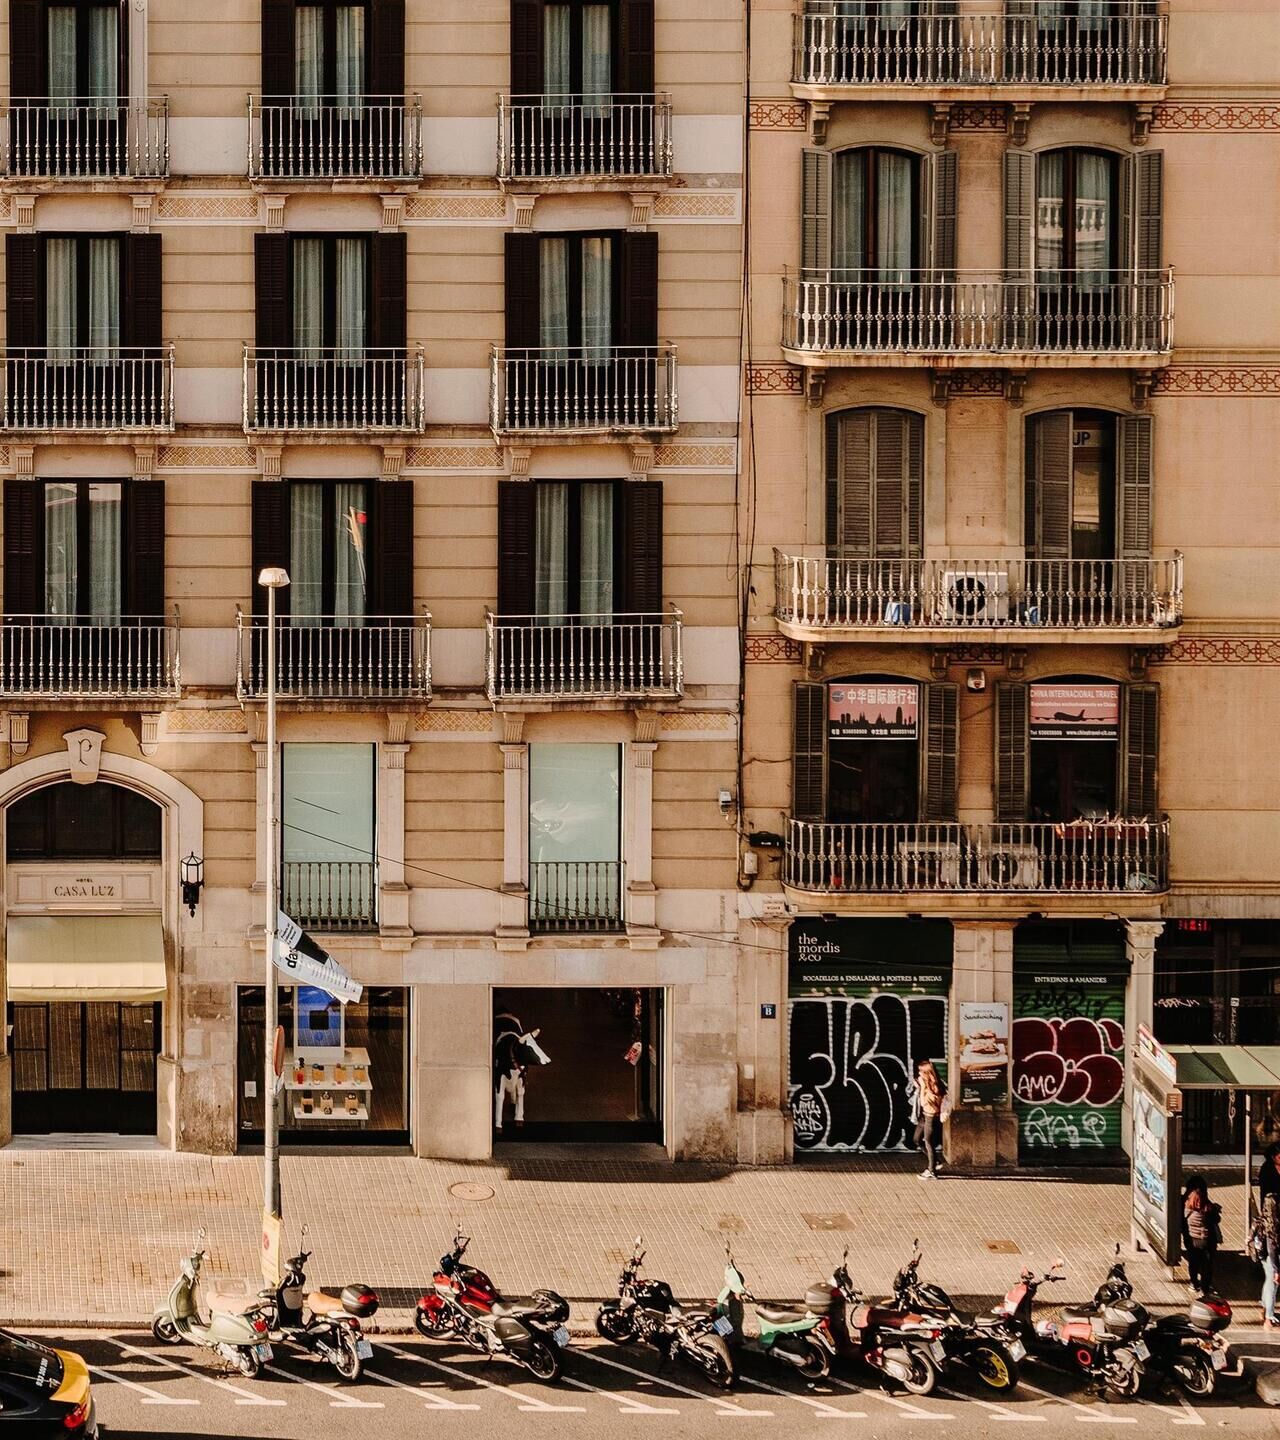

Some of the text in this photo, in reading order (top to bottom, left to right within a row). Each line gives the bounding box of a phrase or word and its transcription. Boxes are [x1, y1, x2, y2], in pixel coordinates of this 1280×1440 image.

[1095, 690, 1118, 699] TRAVEL
[54, 886, 114, 896] CASA LUZ
[798, 933, 818, 944] the
[798, 942, 840, 953] mordis
[964, 1014, 1004, 1022] Sandwiching
[1017, 1074, 1057, 1099] AMC
